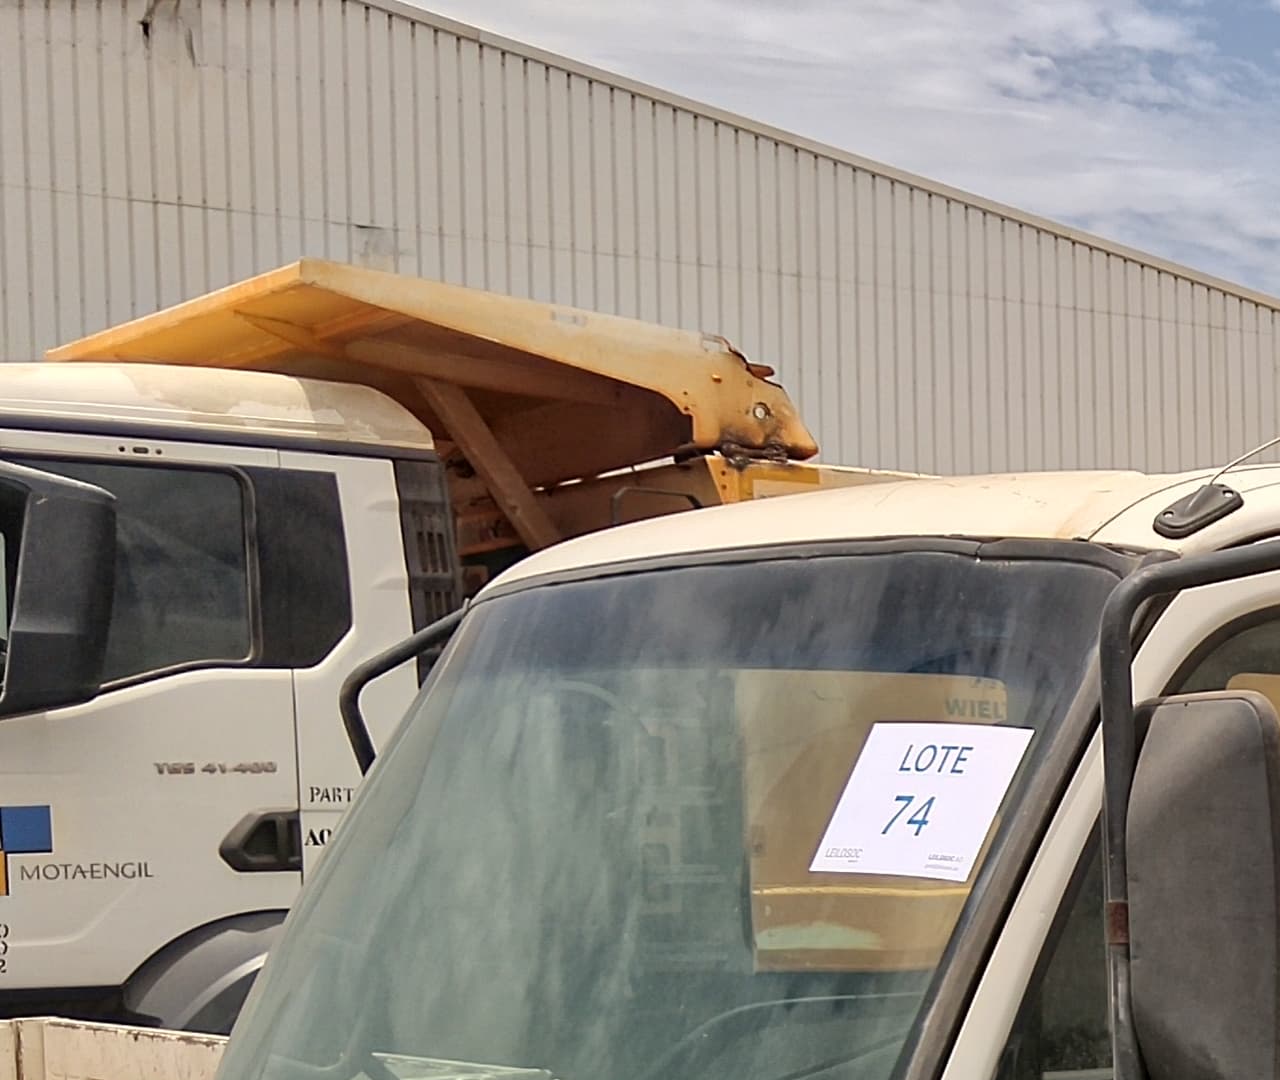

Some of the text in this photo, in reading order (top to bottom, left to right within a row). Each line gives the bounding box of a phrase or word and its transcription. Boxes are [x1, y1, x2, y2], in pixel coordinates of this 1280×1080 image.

[898, 744, 974, 774] LOTE
[309, 786, 354, 803] PART
[881, 795, 936, 837] 74
